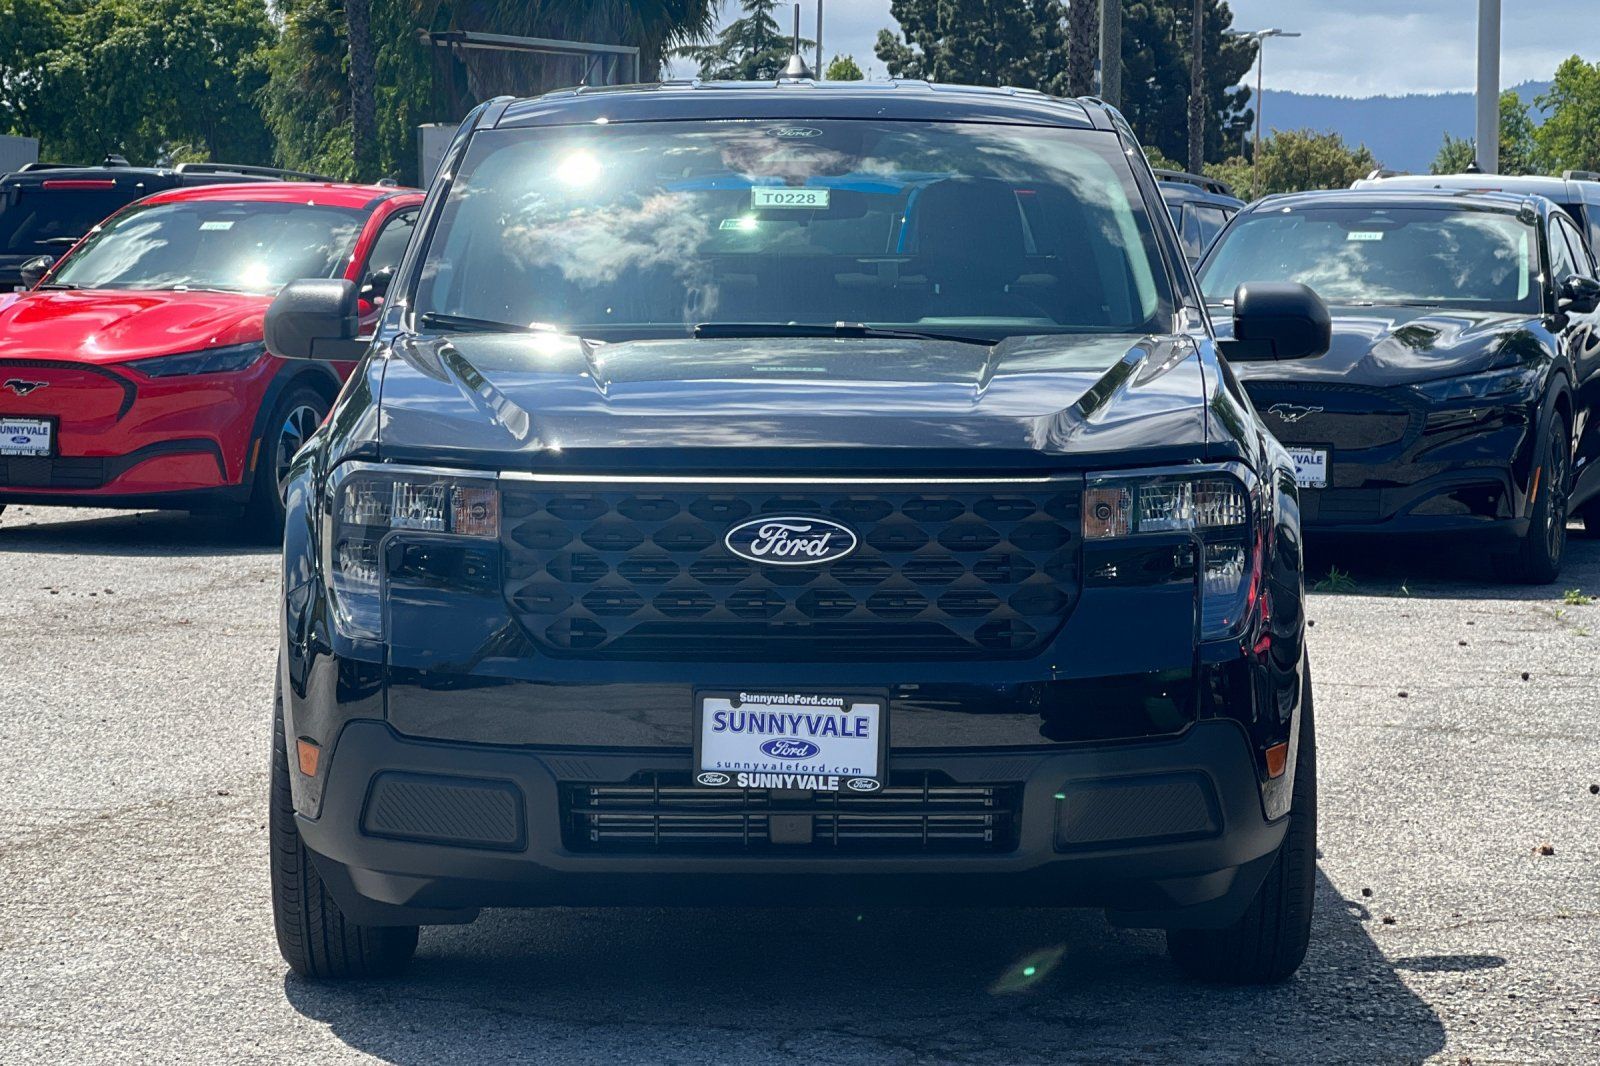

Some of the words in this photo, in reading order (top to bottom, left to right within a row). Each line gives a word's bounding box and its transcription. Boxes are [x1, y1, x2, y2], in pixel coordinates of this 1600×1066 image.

[762, 193, 817, 204] T0228
[0, 425, 48, 435] UNNYVALE
[750, 523, 832, 556] Ford
[739, 692, 844, 706] SunnyvaleFord.com
[712, 710, 870, 738] SUNNYVALE
[716, 760, 862, 775] sunnyvaleford.com
[737, 772, 839, 791] SUNNYVALE
